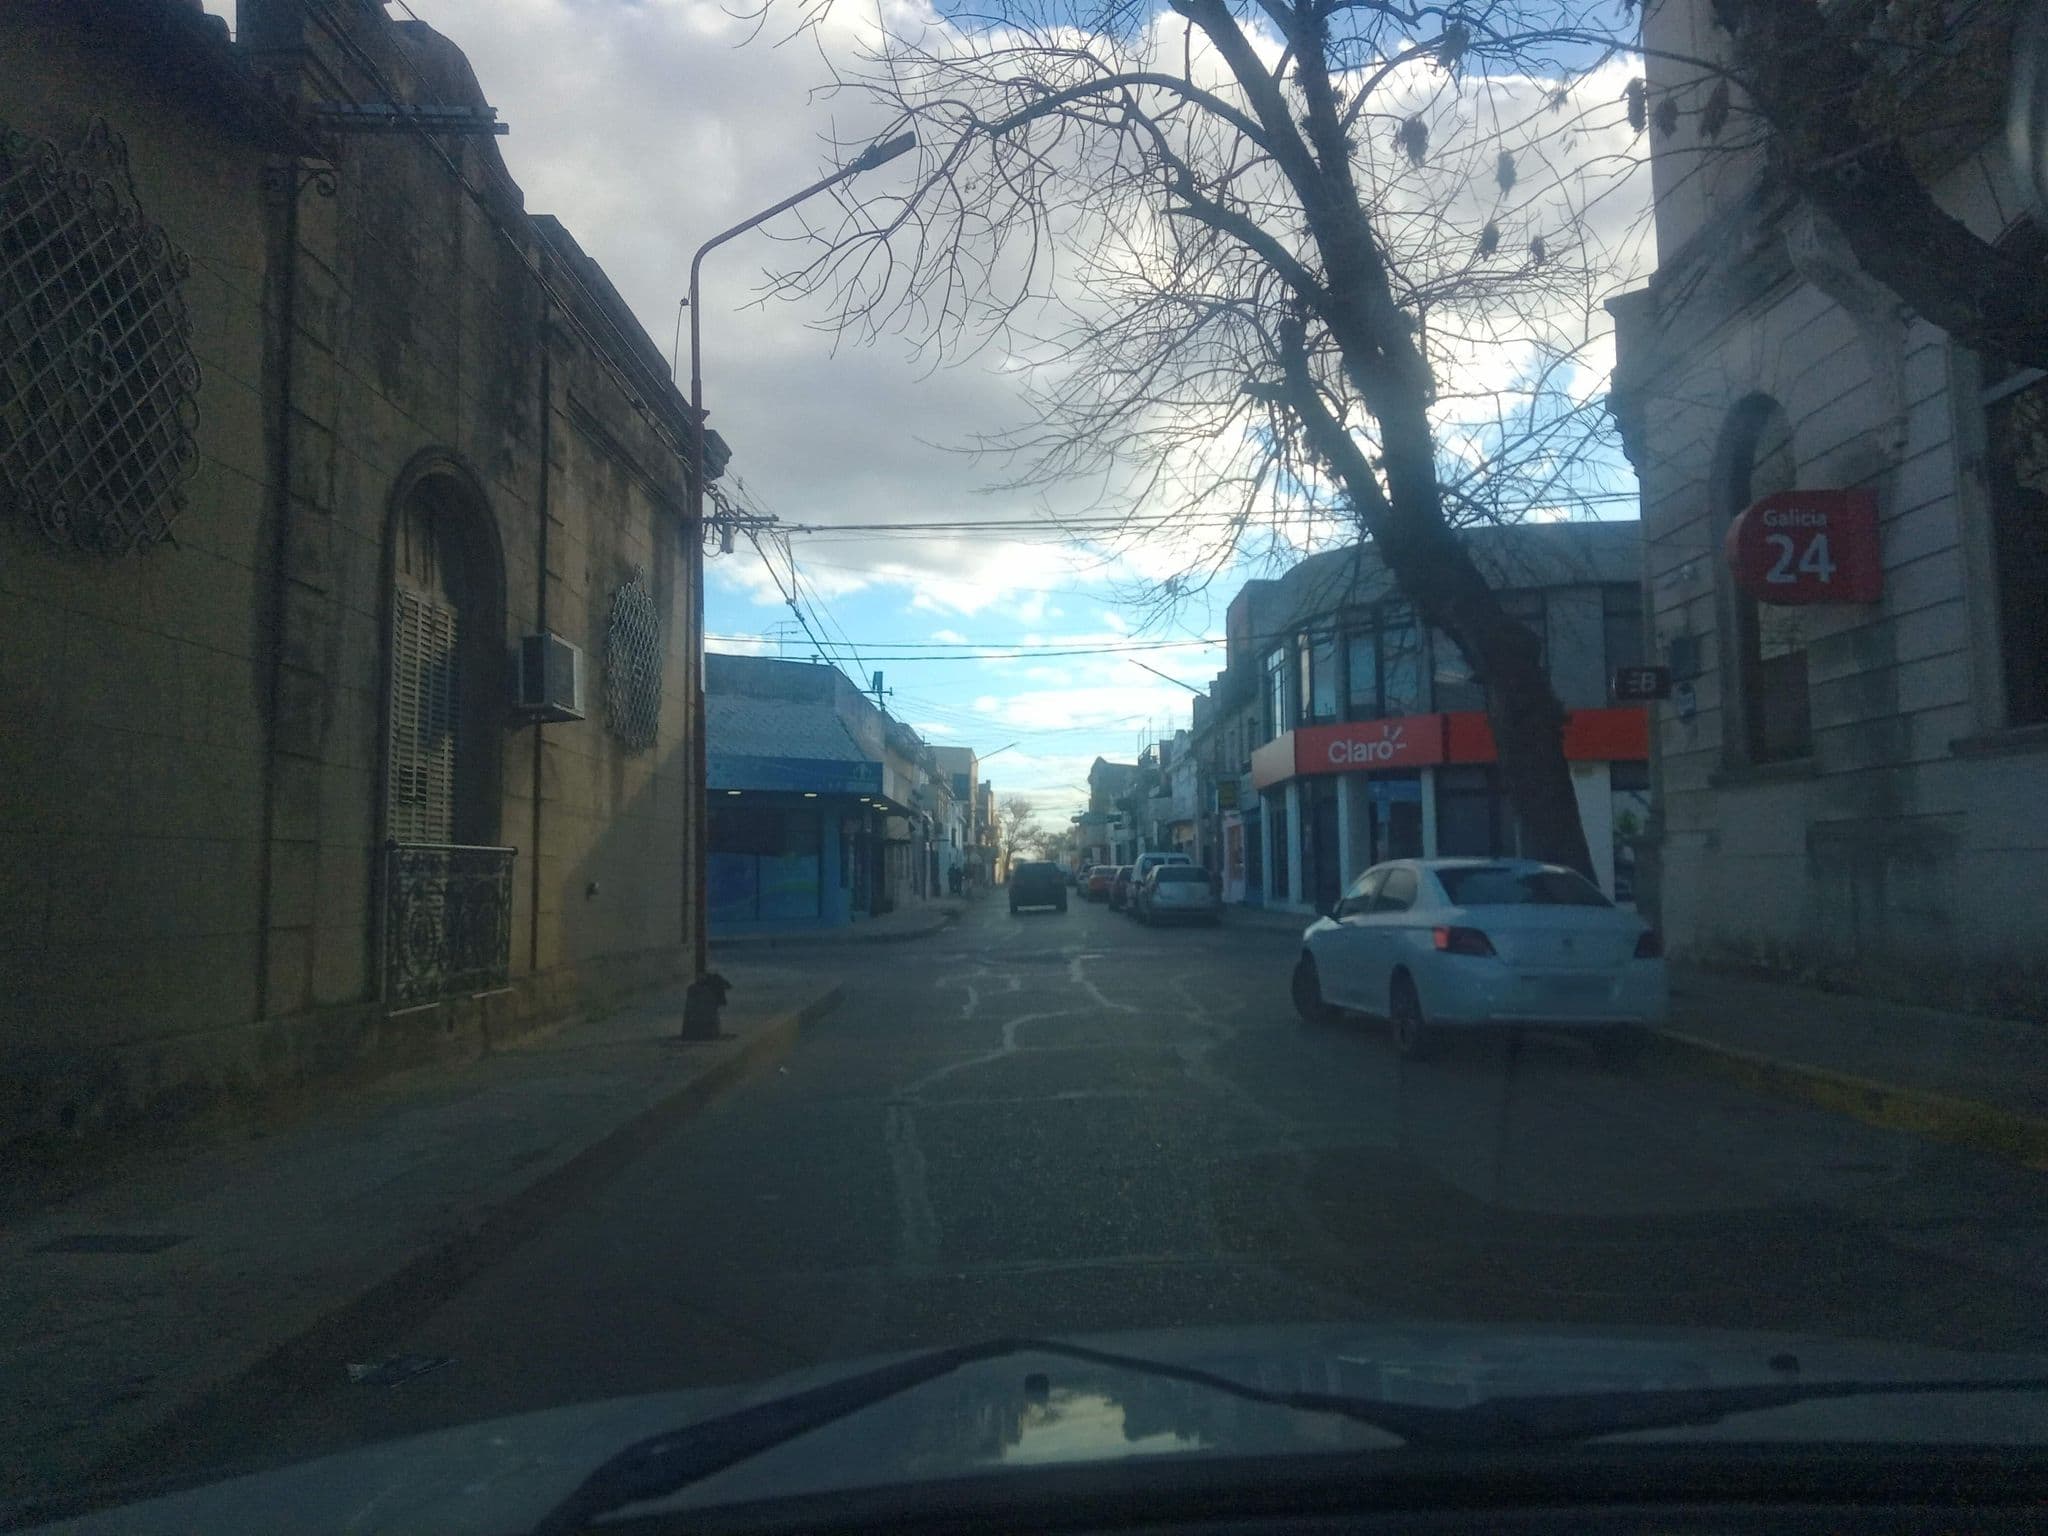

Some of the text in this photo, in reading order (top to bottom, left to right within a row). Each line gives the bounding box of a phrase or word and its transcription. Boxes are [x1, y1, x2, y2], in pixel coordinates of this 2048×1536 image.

[1763, 507, 1828, 528] Galicia
[1765, 532, 1838, 584] 24
[1327, 737, 1394, 765] Claro
